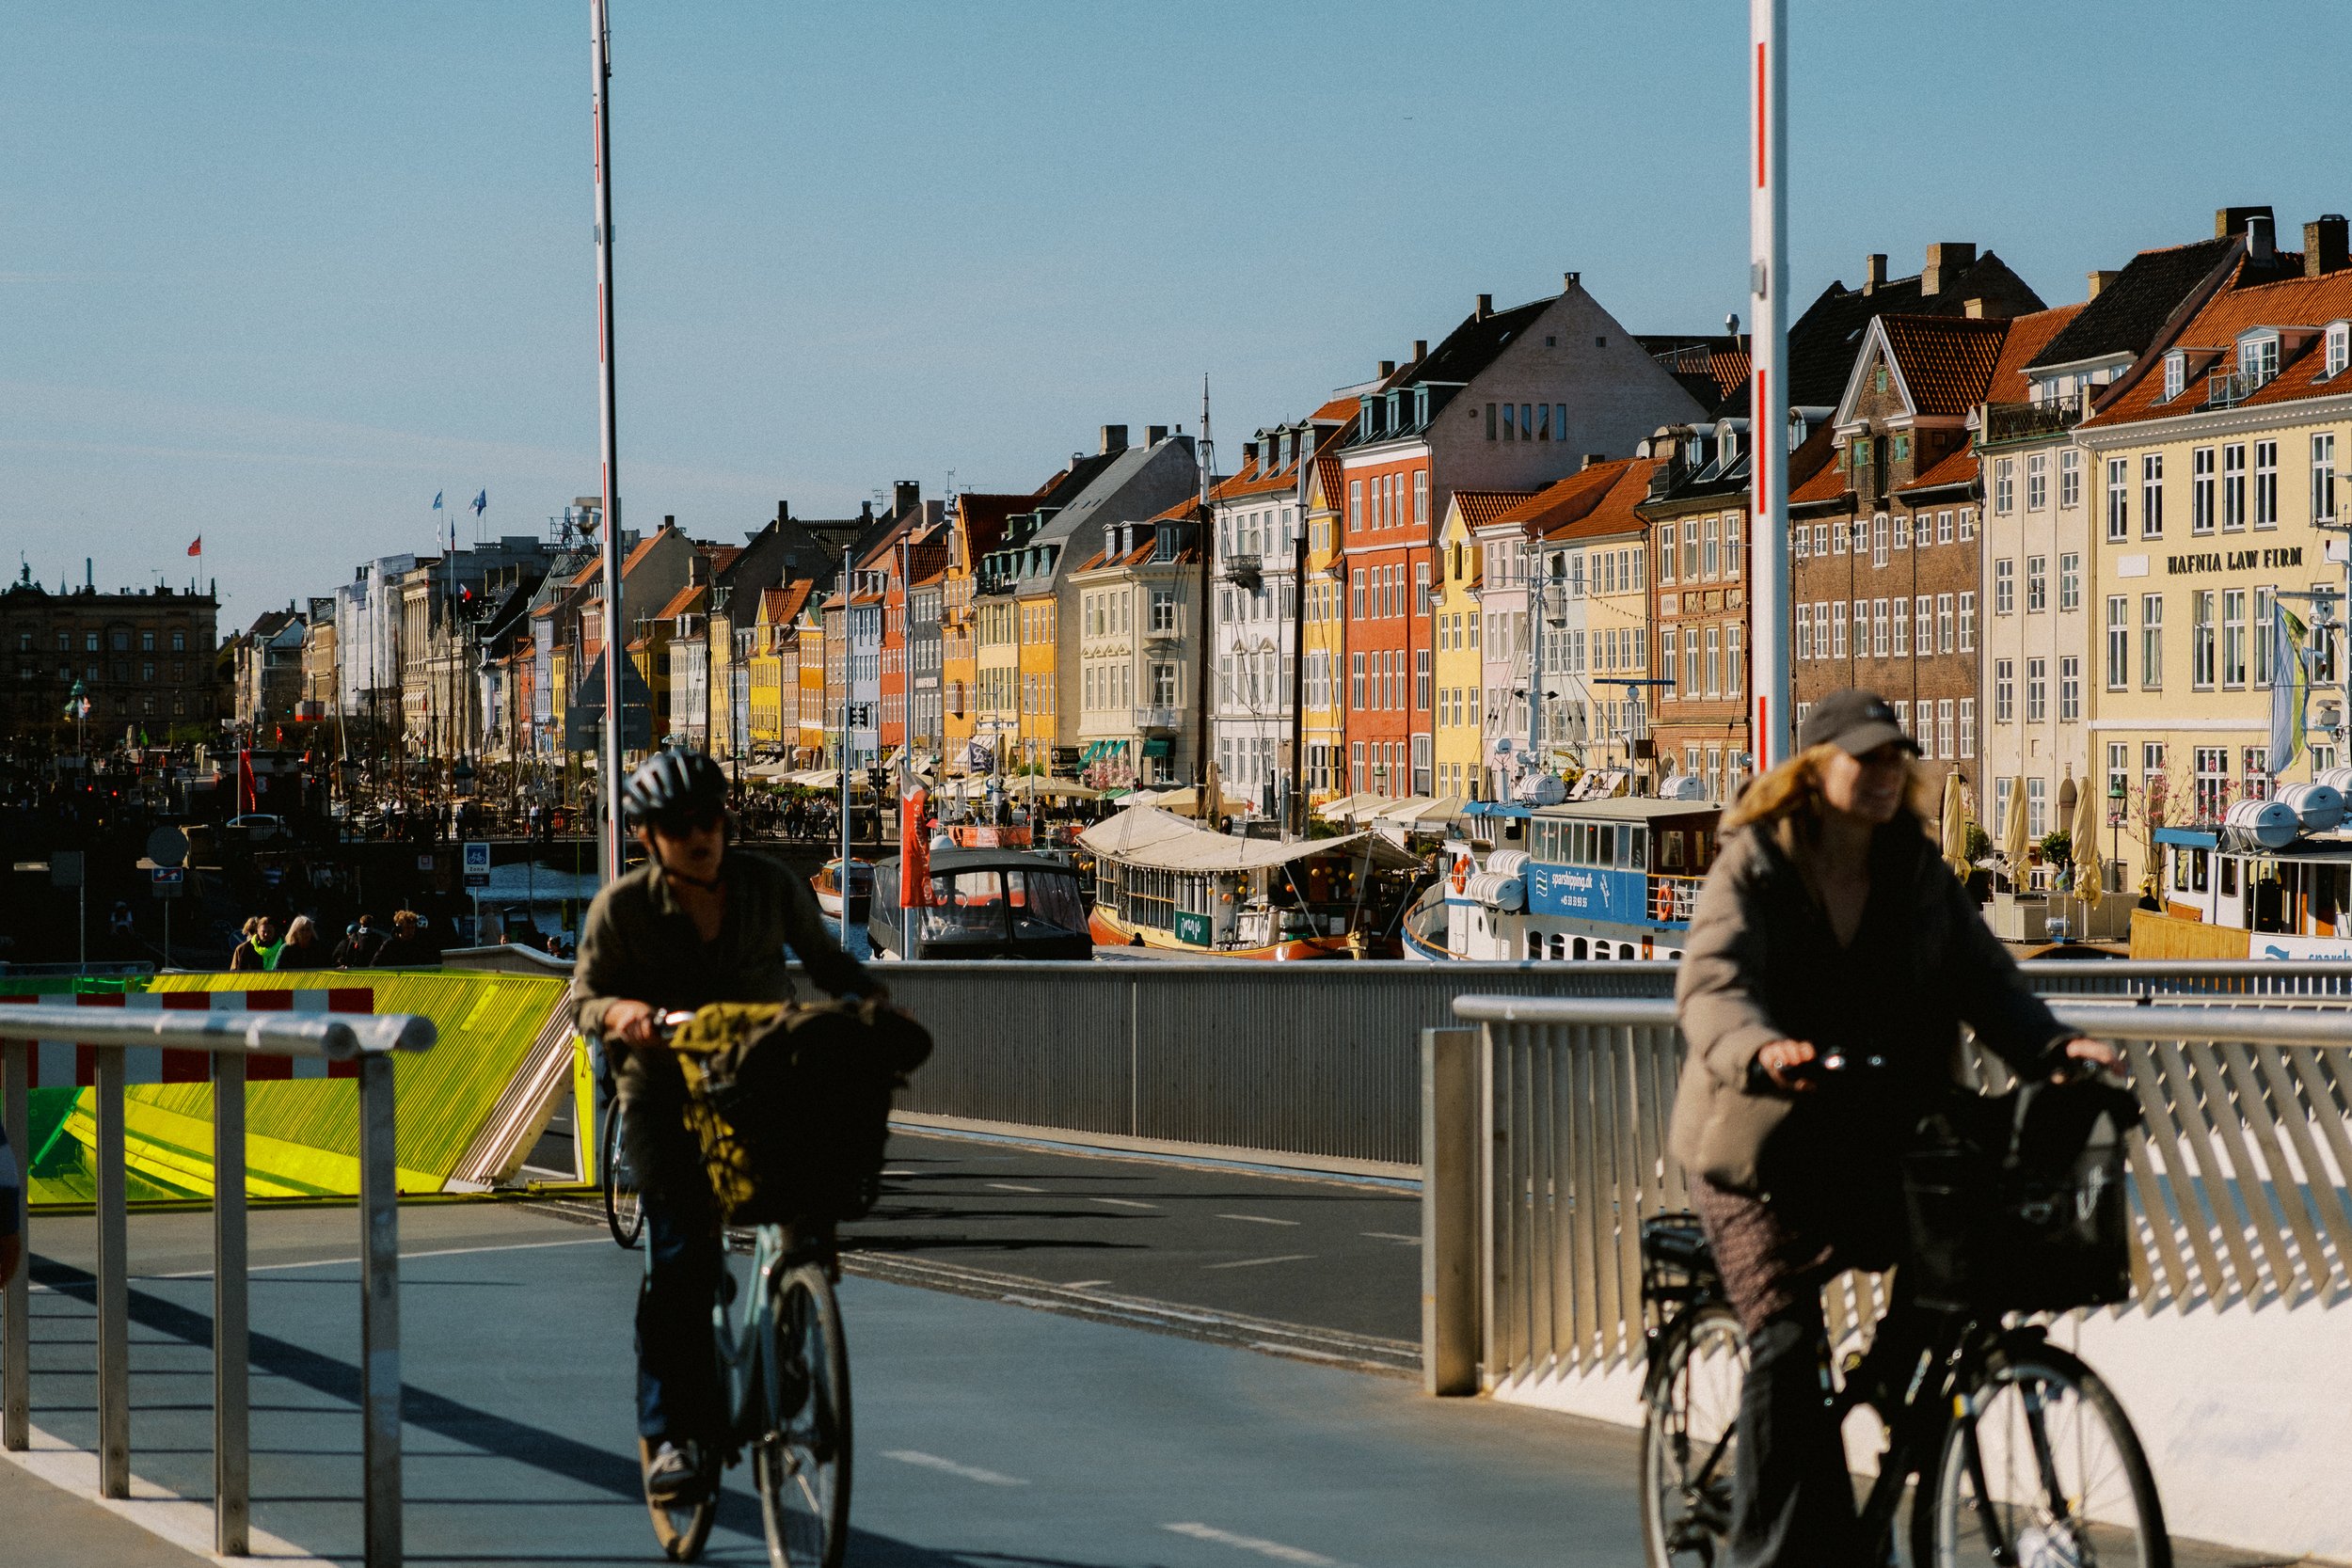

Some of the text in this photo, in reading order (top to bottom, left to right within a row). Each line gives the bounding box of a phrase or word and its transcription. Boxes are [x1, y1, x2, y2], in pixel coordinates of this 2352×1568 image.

[2167, 546, 2303, 576] HAFNIA LAW FIRM
[1551, 870, 1593, 892] sparshipping.dk
